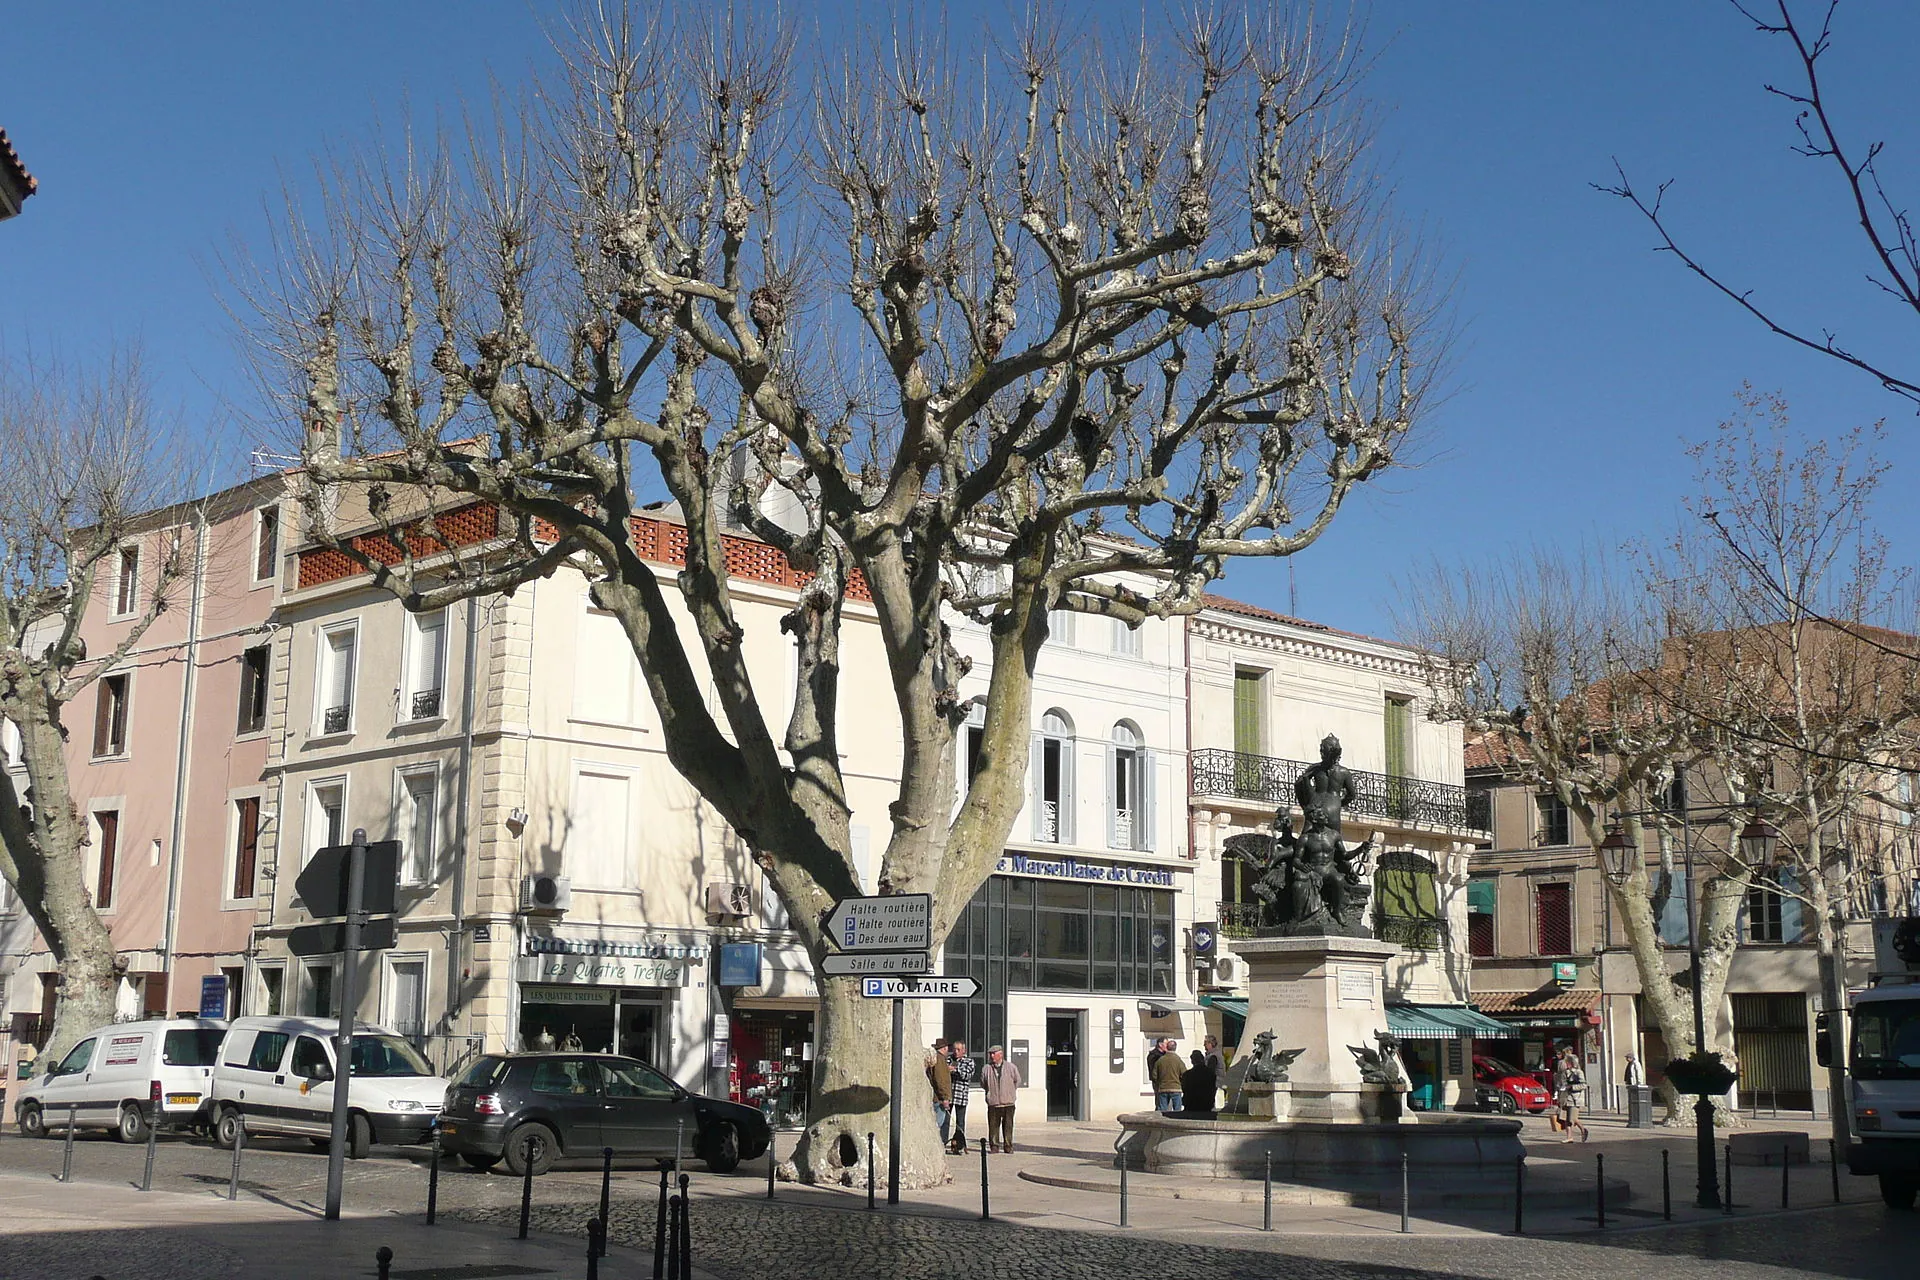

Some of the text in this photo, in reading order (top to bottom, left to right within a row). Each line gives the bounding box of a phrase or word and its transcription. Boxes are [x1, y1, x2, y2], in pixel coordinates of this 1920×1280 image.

[1012, 855, 1105, 880] Marseillaise
[1107, 864, 1126, 881] de
[851, 902, 925, 915] Halte routière
[859, 918, 883, 929] Halte
[887, 916, 924, 928] routière
[859, 935, 874, 944] Des
[878, 934, 899, 943] deux
[903, 933, 925, 943] eaux
[543, 959, 567, 976] Les
[574, 961, 625, 979] Quatre
[850, 957, 924, 969] Salle du Réal
[887, 982, 959, 993] VOLTAIRE
[530, 991, 543, 1000] LES
[545, 992, 573, 1000] QUATRE
